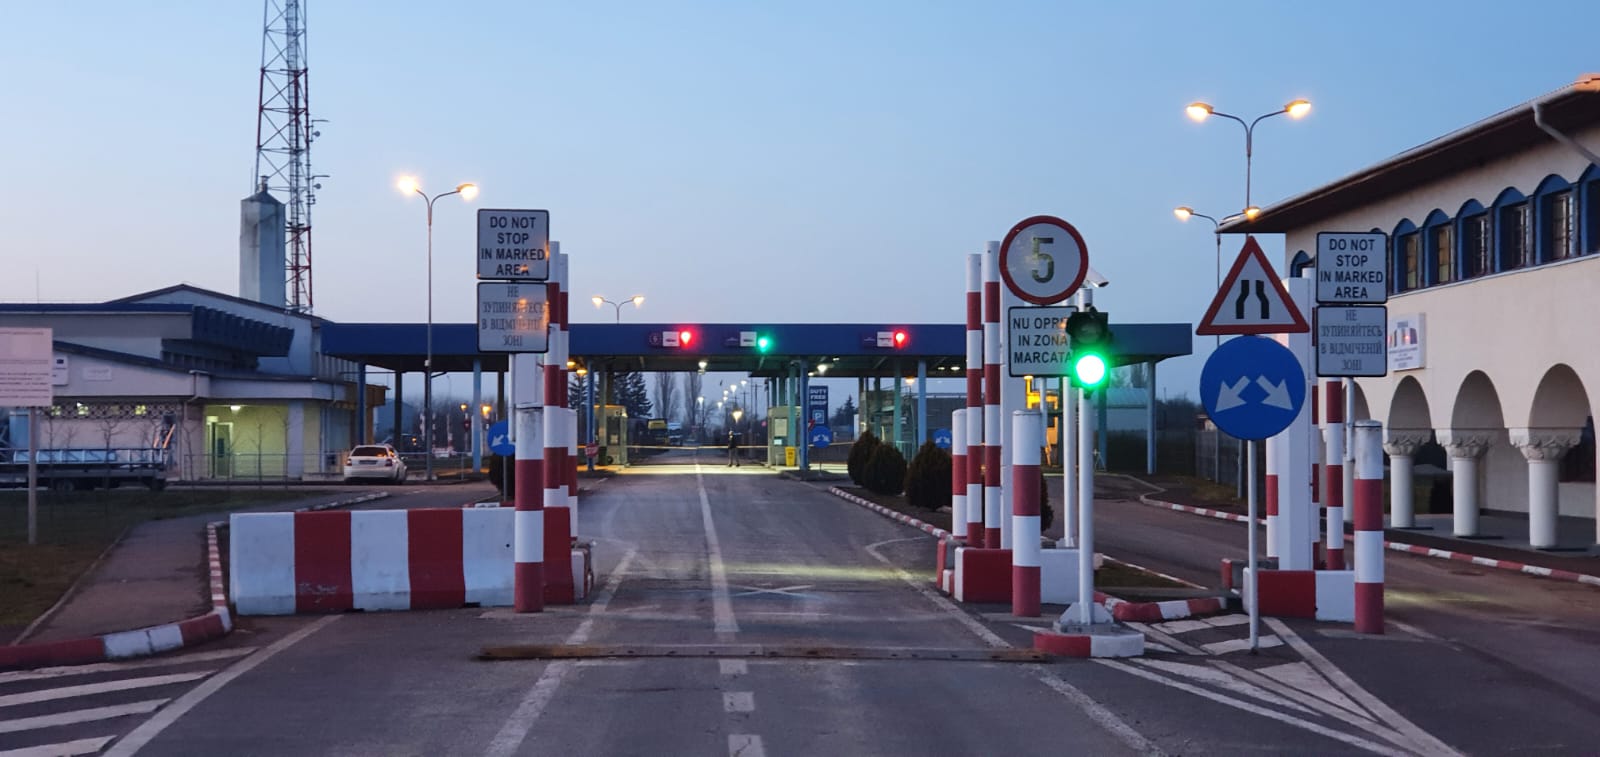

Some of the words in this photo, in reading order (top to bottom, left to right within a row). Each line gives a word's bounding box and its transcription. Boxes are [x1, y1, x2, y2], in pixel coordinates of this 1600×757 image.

[490, 216, 507, 228] DO
[511, 217, 536, 229] NOT
[497, 232, 529, 244] STOP
[1329, 239, 1347, 251] DO
[1351, 239, 1375, 251] NOT
[481, 248, 492, 260] IN
[496, 249, 545, 261] MARKED
[1032, 238, 1054, 283] 5
[1336, 255, 1368, 267] STOP
[1320, 271, 1331, 283] IN
[1335, 271, 1383, 283] MARKED
[507, 286, 519, 298] НЕ
[1334, 287, 1368, 298] AREA
[1345, 310, 1357, 321] НЕ
[481, 319, 488, 330] В
[1013, 318, 1030, 330] NU
[1321, 324, 1383, 337] ЗУПИНЯЙТЕСЬ
[503, 335, 523, 347] ЗОНІ
[1018, 335, 1030, 347] IN
[1034, 335, 1068, 347] ZONA
[1321, 343, 1327, 355] В
[1329, 341, 1382, 355] ВІДМІЧЕНІЙ
[1342, 359, 1362, 371] ЗОНІ
